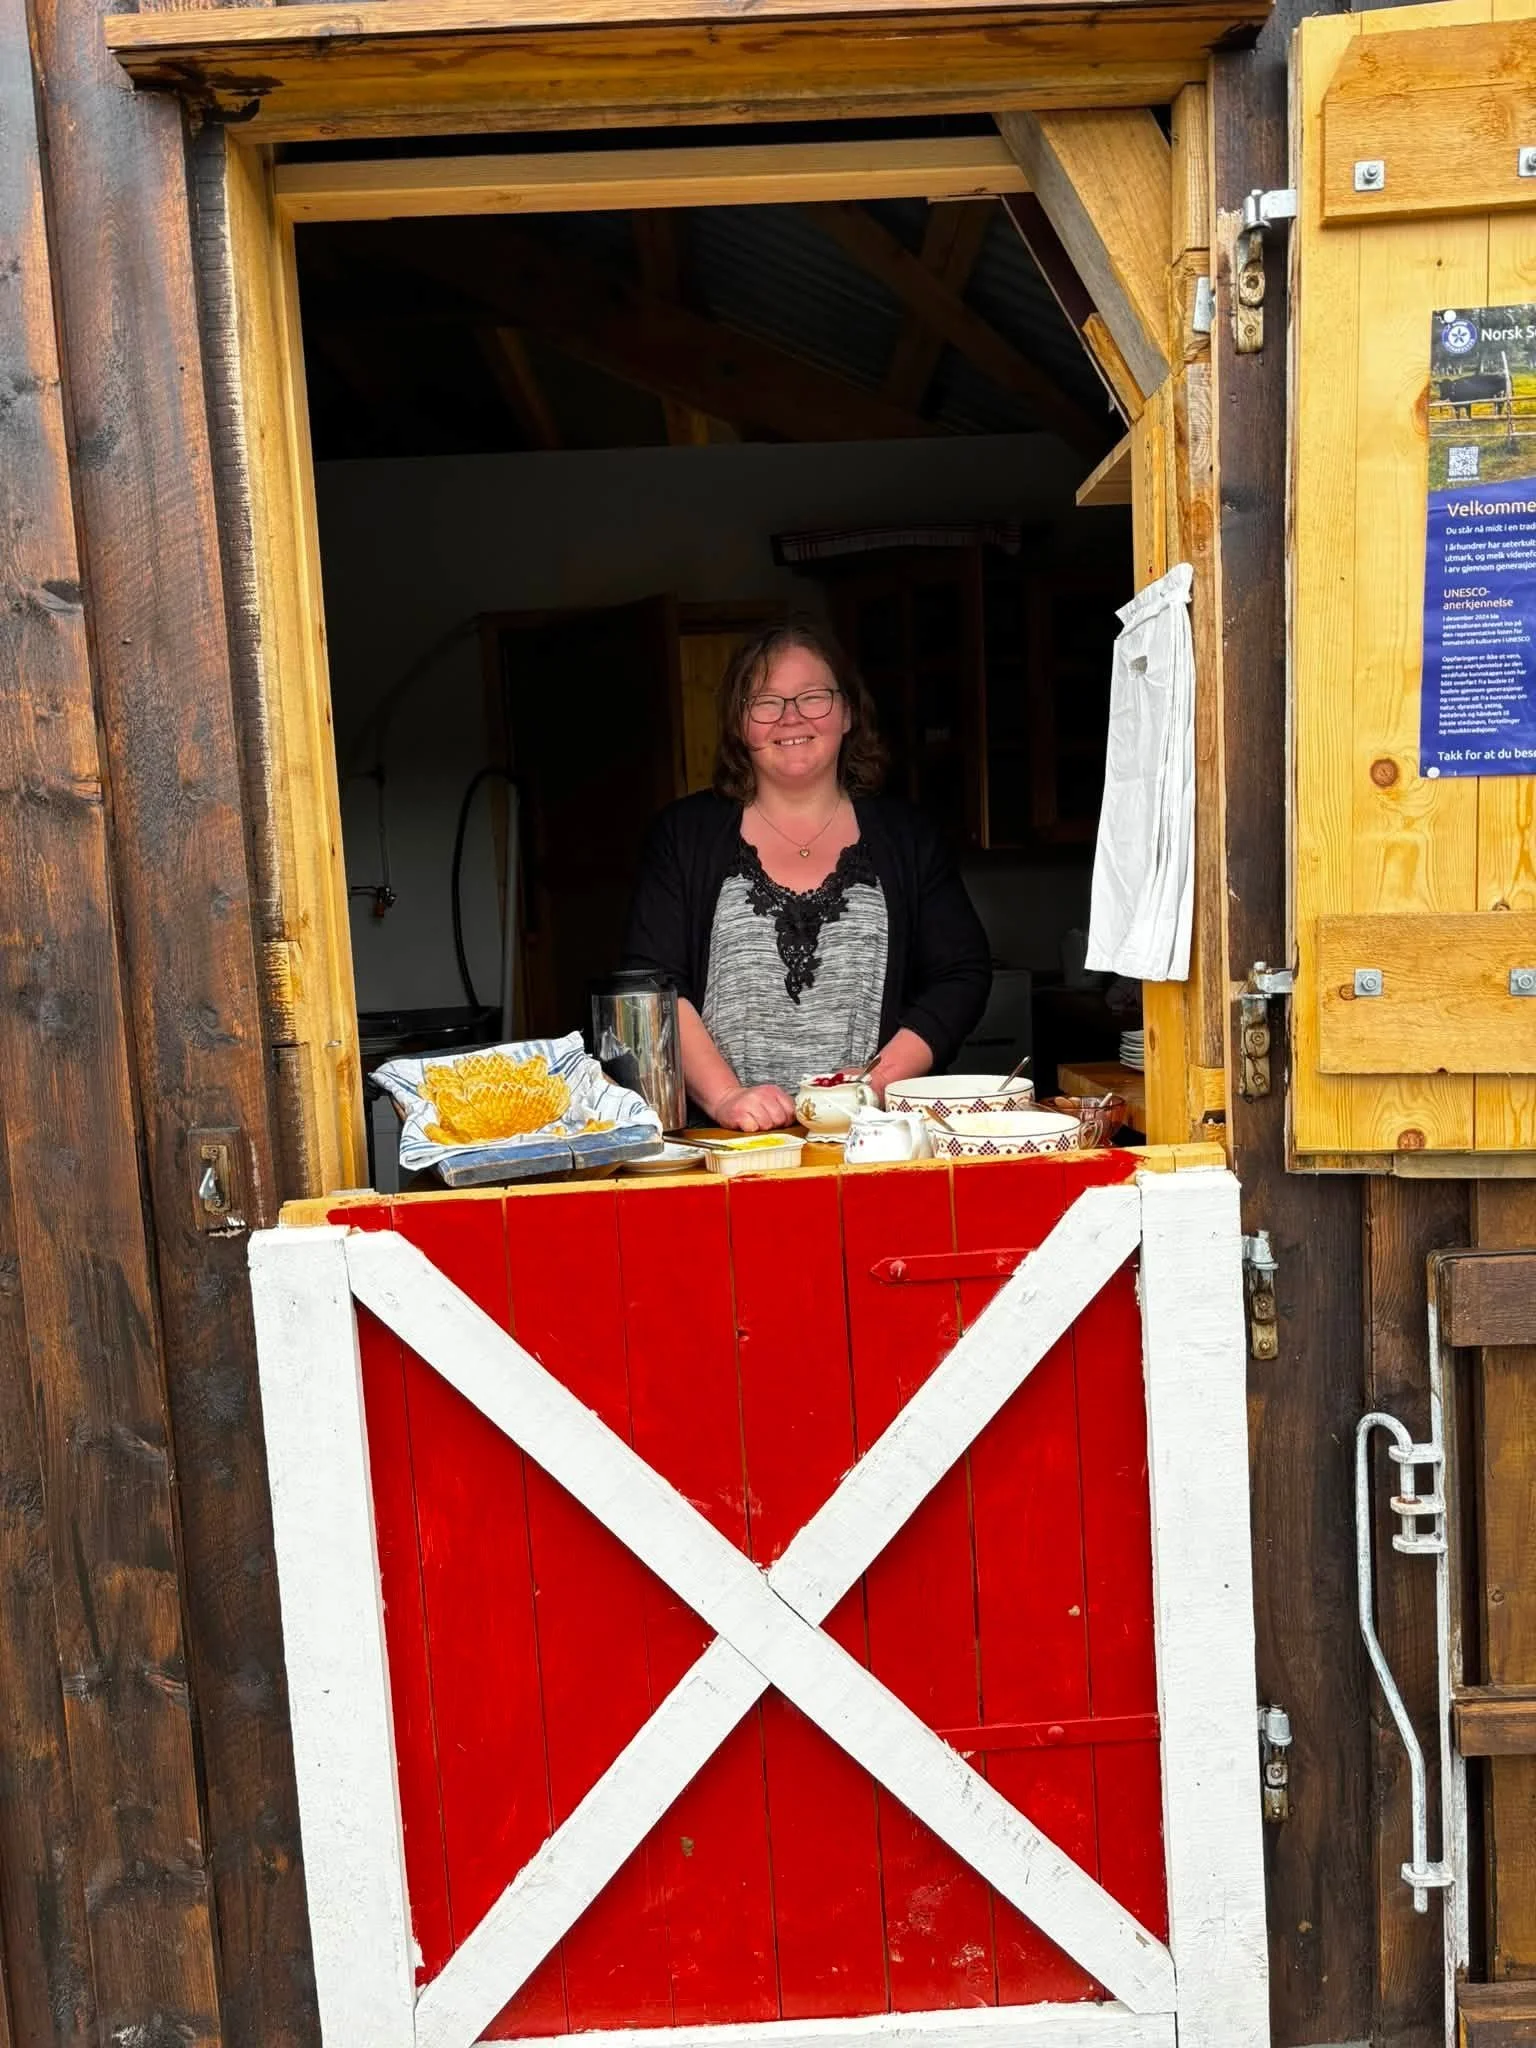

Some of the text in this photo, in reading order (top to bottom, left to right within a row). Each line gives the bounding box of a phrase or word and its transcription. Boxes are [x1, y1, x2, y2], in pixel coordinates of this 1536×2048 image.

[1481, 326, 1523, 341] Norsk
[1446, 527, 1457, 535] Du
[1458, 526, 1473, 534] står
[1474, 525, 1484, 533] nå
[1485, 524, 1503, 532] midt
[1488, 541, 1500, 549] har
[1487, 551, 1505, 560] melk
[1461, 564, 1494, 574] gjennom
[1444, 587, 1491, 598] UNESCO-
[1443, 598, 1514, 611] anerkjennelse
[1437, 750, 1463, 761] Takk
[1465, 750, 1482, 760] for
[1484, 750, 1495, 759] at
[1498, 748, 1512, 759] du
